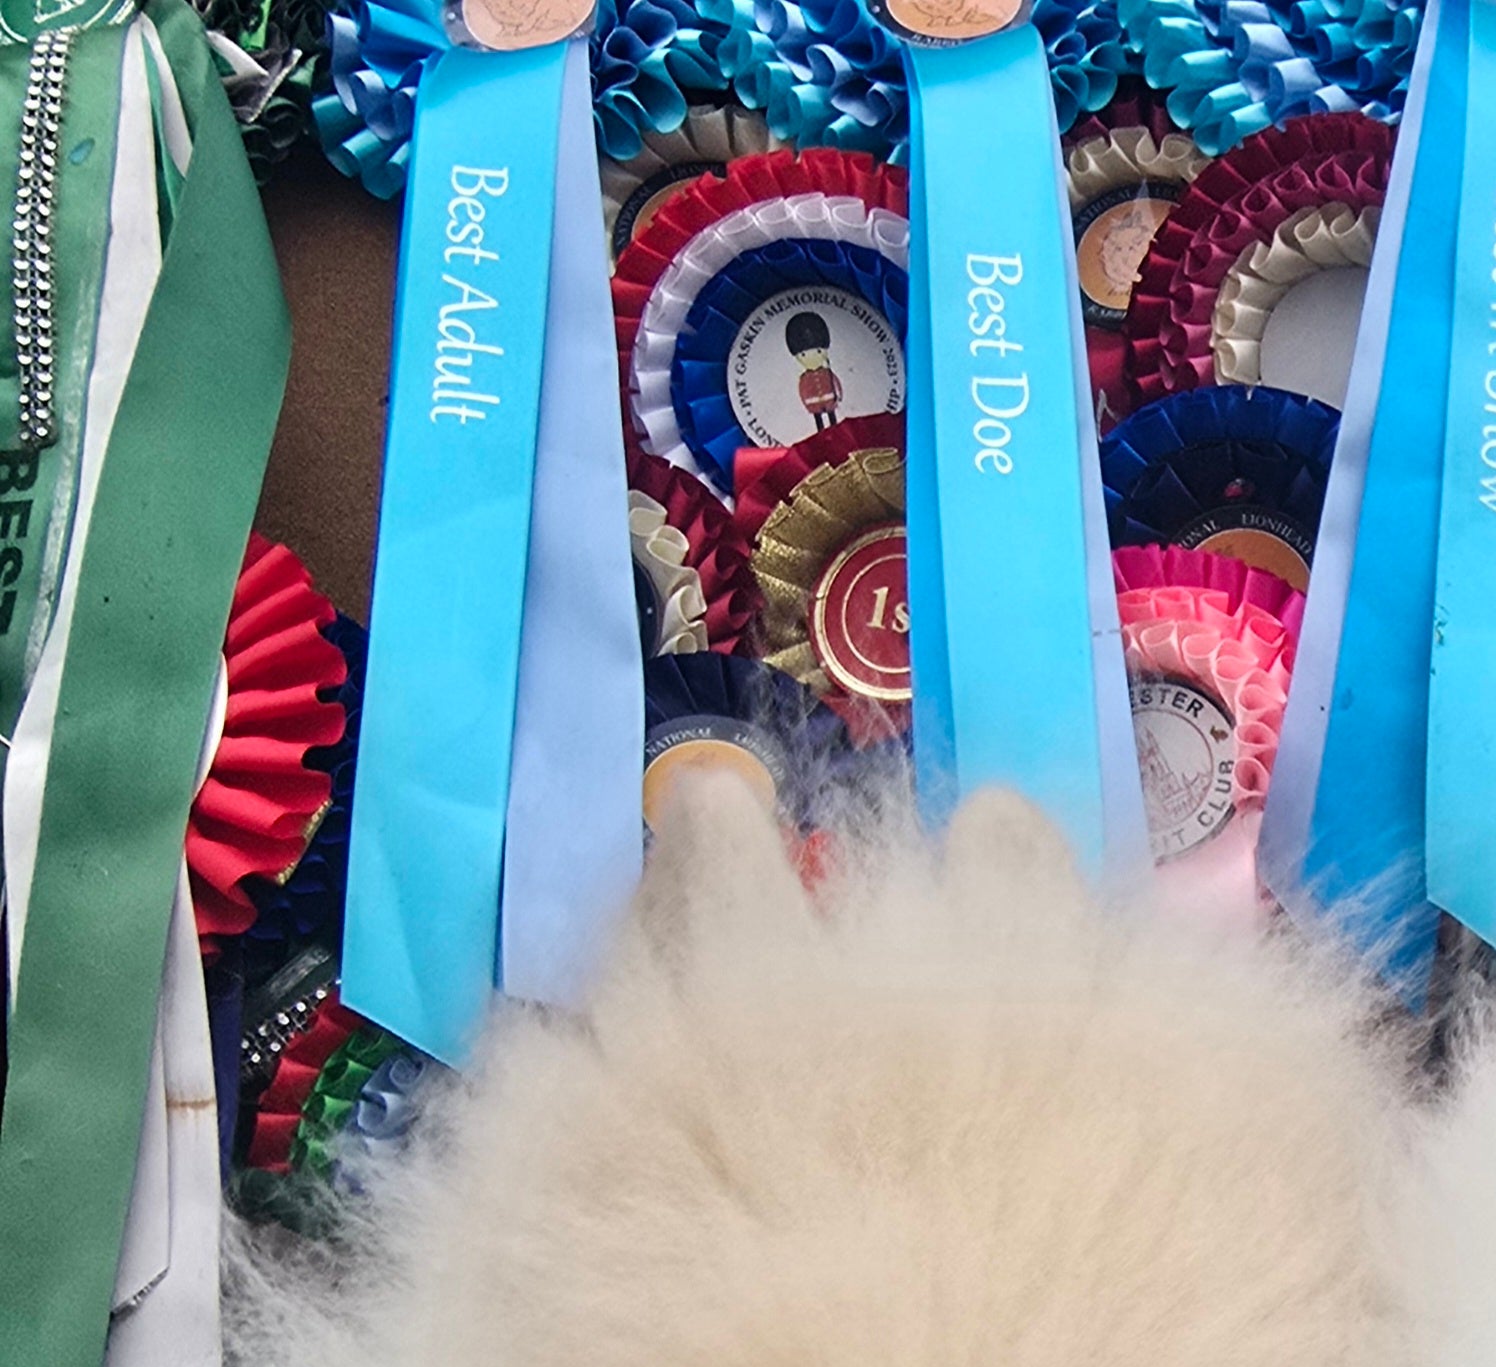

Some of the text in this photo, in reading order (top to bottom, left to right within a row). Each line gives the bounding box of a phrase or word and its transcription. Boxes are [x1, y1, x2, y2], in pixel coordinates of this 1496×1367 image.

[429, 165, 509, 424] Best Adult
[764, 291, 848, 322] MEMORIAL
[851, 303, 889, 344] SHOW
[735, 318, 765, 376] GASKIN
[965, 251, 1031, 475] Best Doe
[735, 380, 752, 408] PAT
[1241, 513, 1313, 554] LIONHEAD
[646, 727, 712, 757] NATIONAL
[1197, 759, 1235, 828] CLUB
